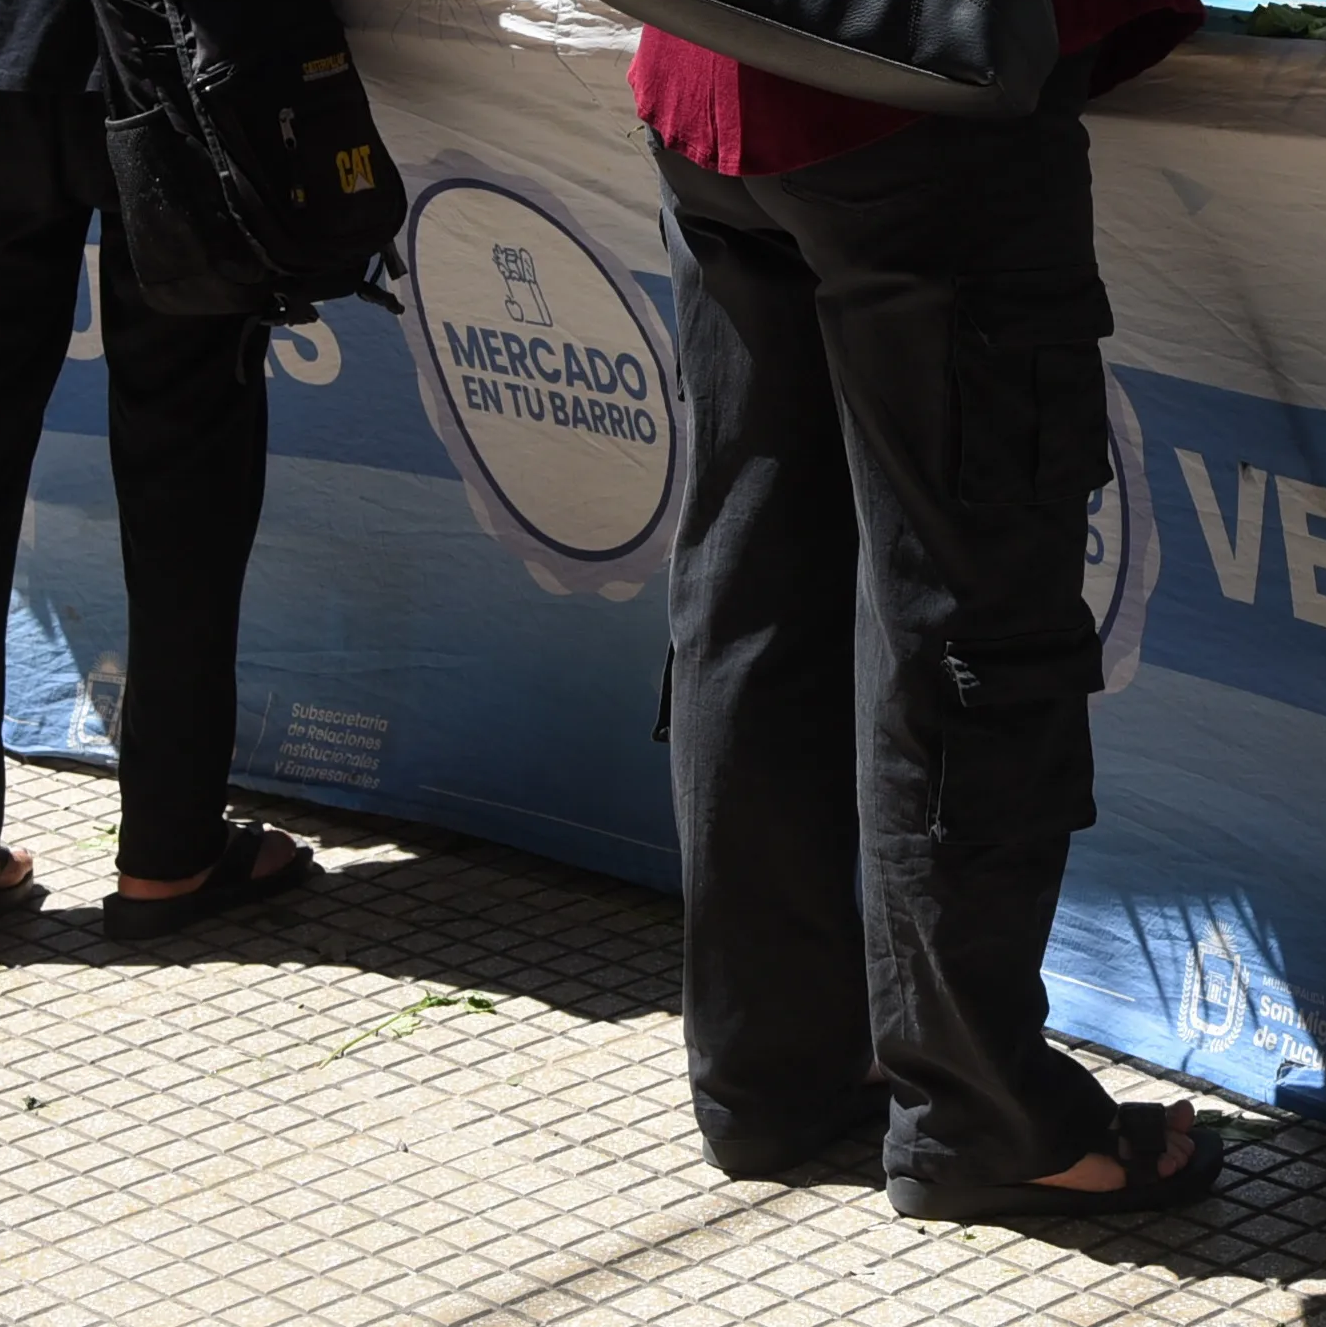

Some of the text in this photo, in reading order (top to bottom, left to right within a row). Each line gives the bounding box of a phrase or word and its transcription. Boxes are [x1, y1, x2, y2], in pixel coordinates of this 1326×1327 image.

[335, 143, 376, 195] CAT
[442, 321, 648, 402] MERCADO
[461, 374, 657, 445] EN TU BARRIO
[287, 721, 383, 751] de Relaciones
[1259, 994, 1295, 1027] San
[1252, 1024, 1278, 1051] de
